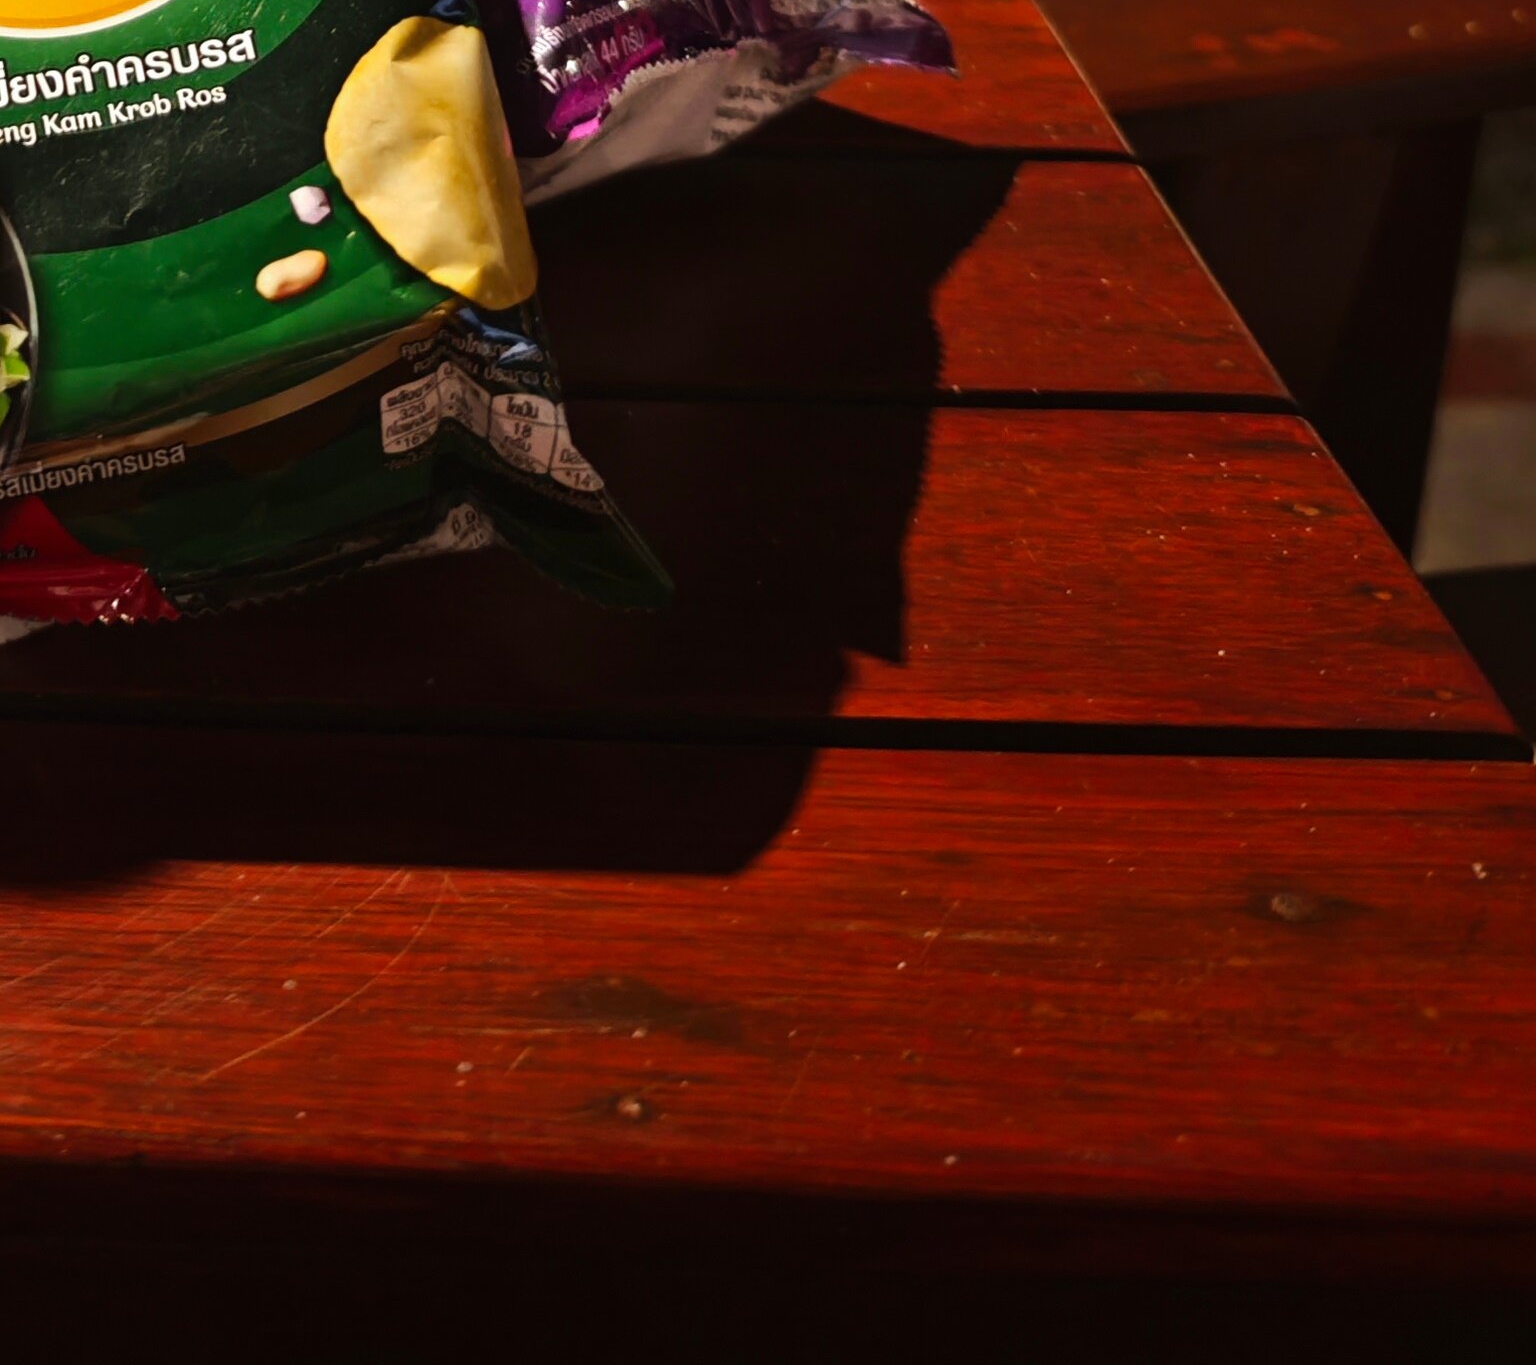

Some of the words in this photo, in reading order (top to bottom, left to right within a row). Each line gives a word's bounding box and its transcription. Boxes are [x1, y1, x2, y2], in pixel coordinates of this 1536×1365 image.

[41, 107, 103, 137] Kam
[107, 92, 172, 126] Krob
[176, 85, 228, 112] Ros
